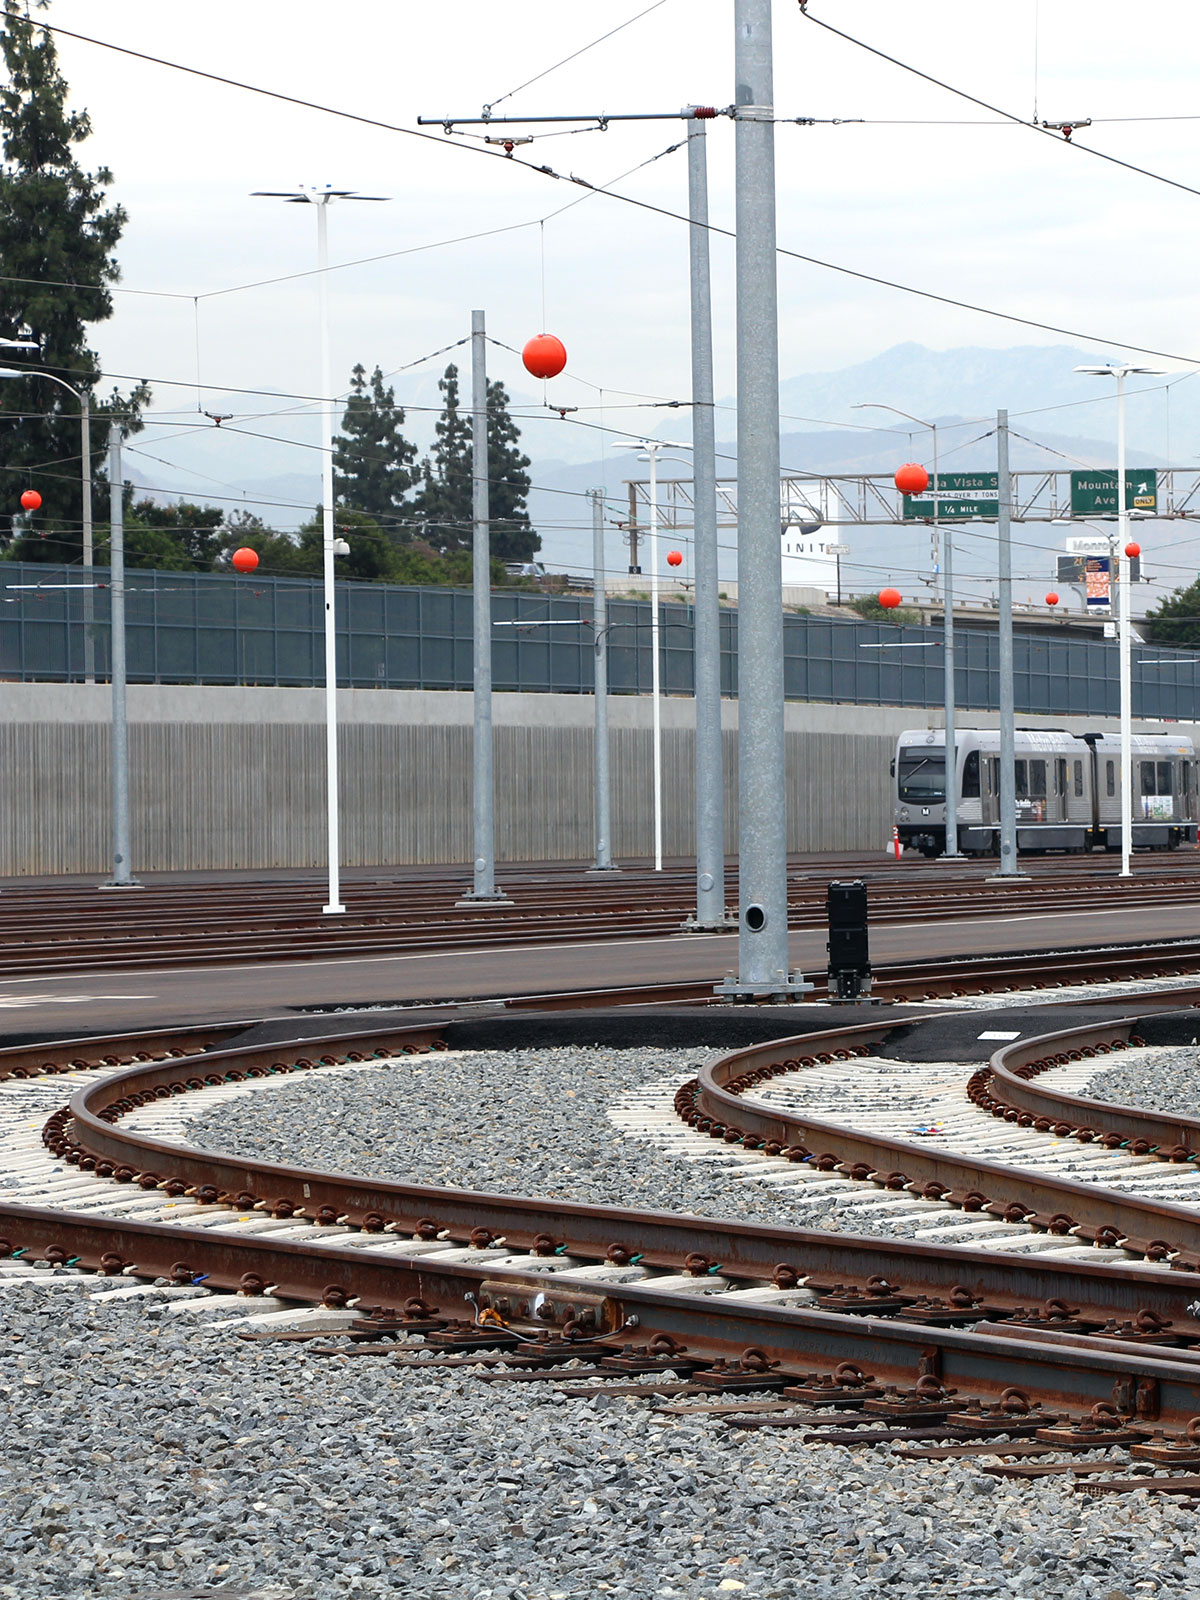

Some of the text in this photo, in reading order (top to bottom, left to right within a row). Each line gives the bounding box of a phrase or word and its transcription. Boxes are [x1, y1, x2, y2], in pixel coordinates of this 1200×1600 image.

[1078, 481, 1133, 491] Mountan
[982, 490, 998, 498] TONS
[1095, 495, 1116, 505] Ave
[1135, 497, 1153, 505] ONLY
[960, 505, 979, 513] MILE
[787, 543, 828, 553] INIT
